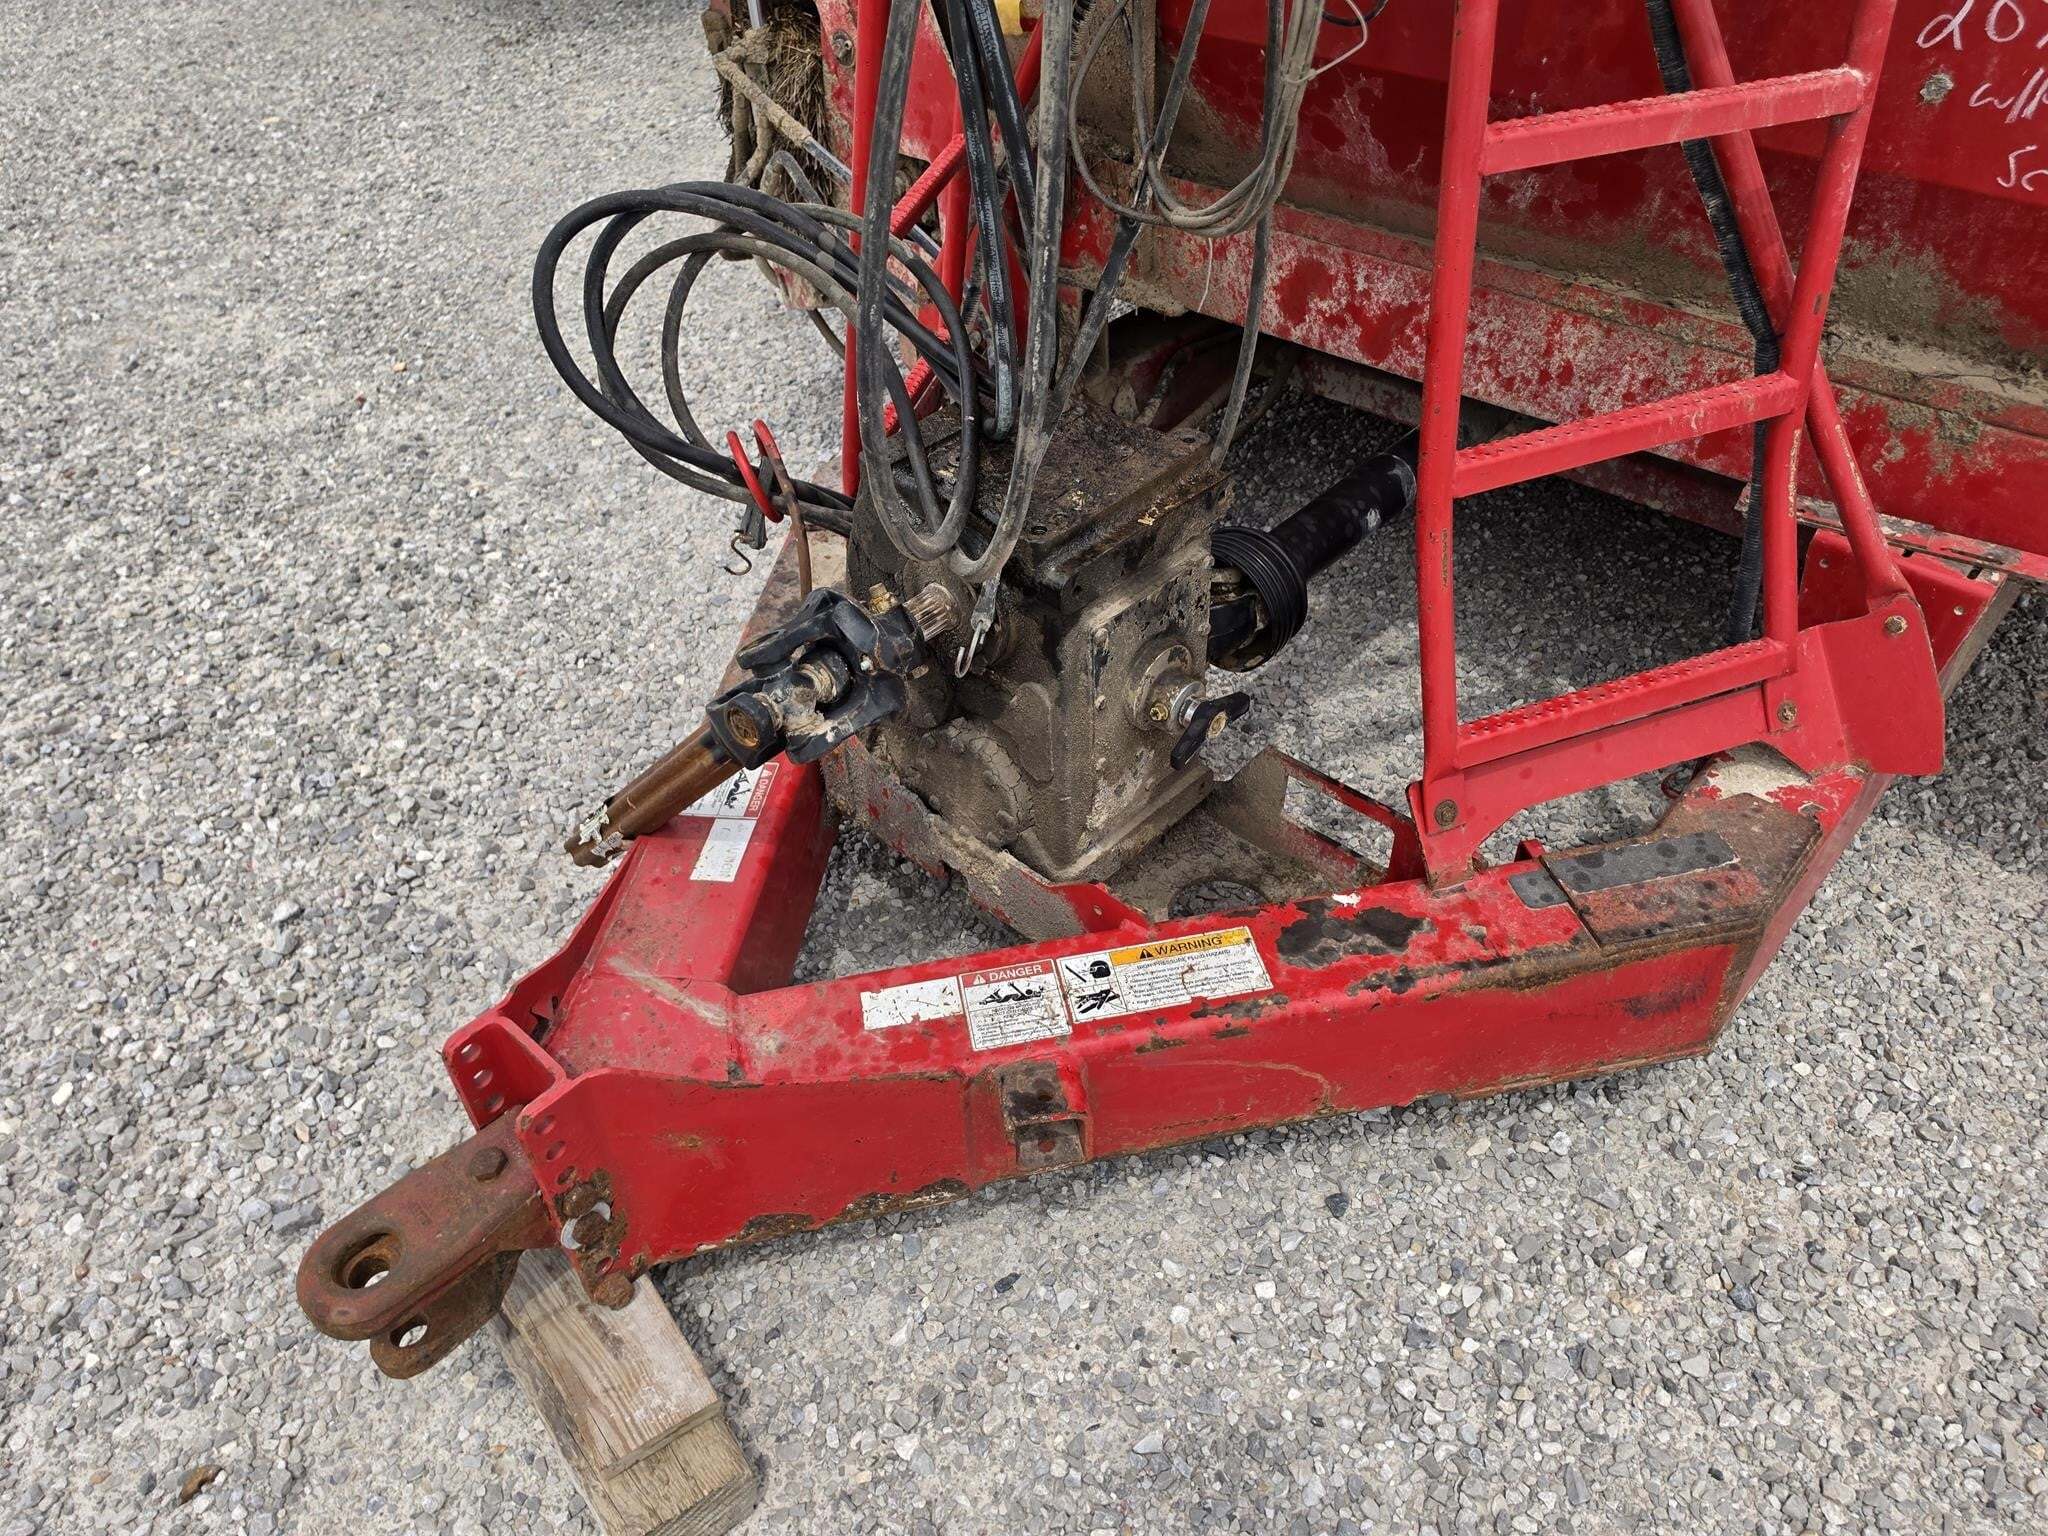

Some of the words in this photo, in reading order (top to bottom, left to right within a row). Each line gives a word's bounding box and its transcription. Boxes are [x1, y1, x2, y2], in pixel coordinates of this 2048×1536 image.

[748, 778, 769, 811] DANGER
[1154, 936, 1223, 955] WARNING
[989, 964, 1043, 980] DANGER
